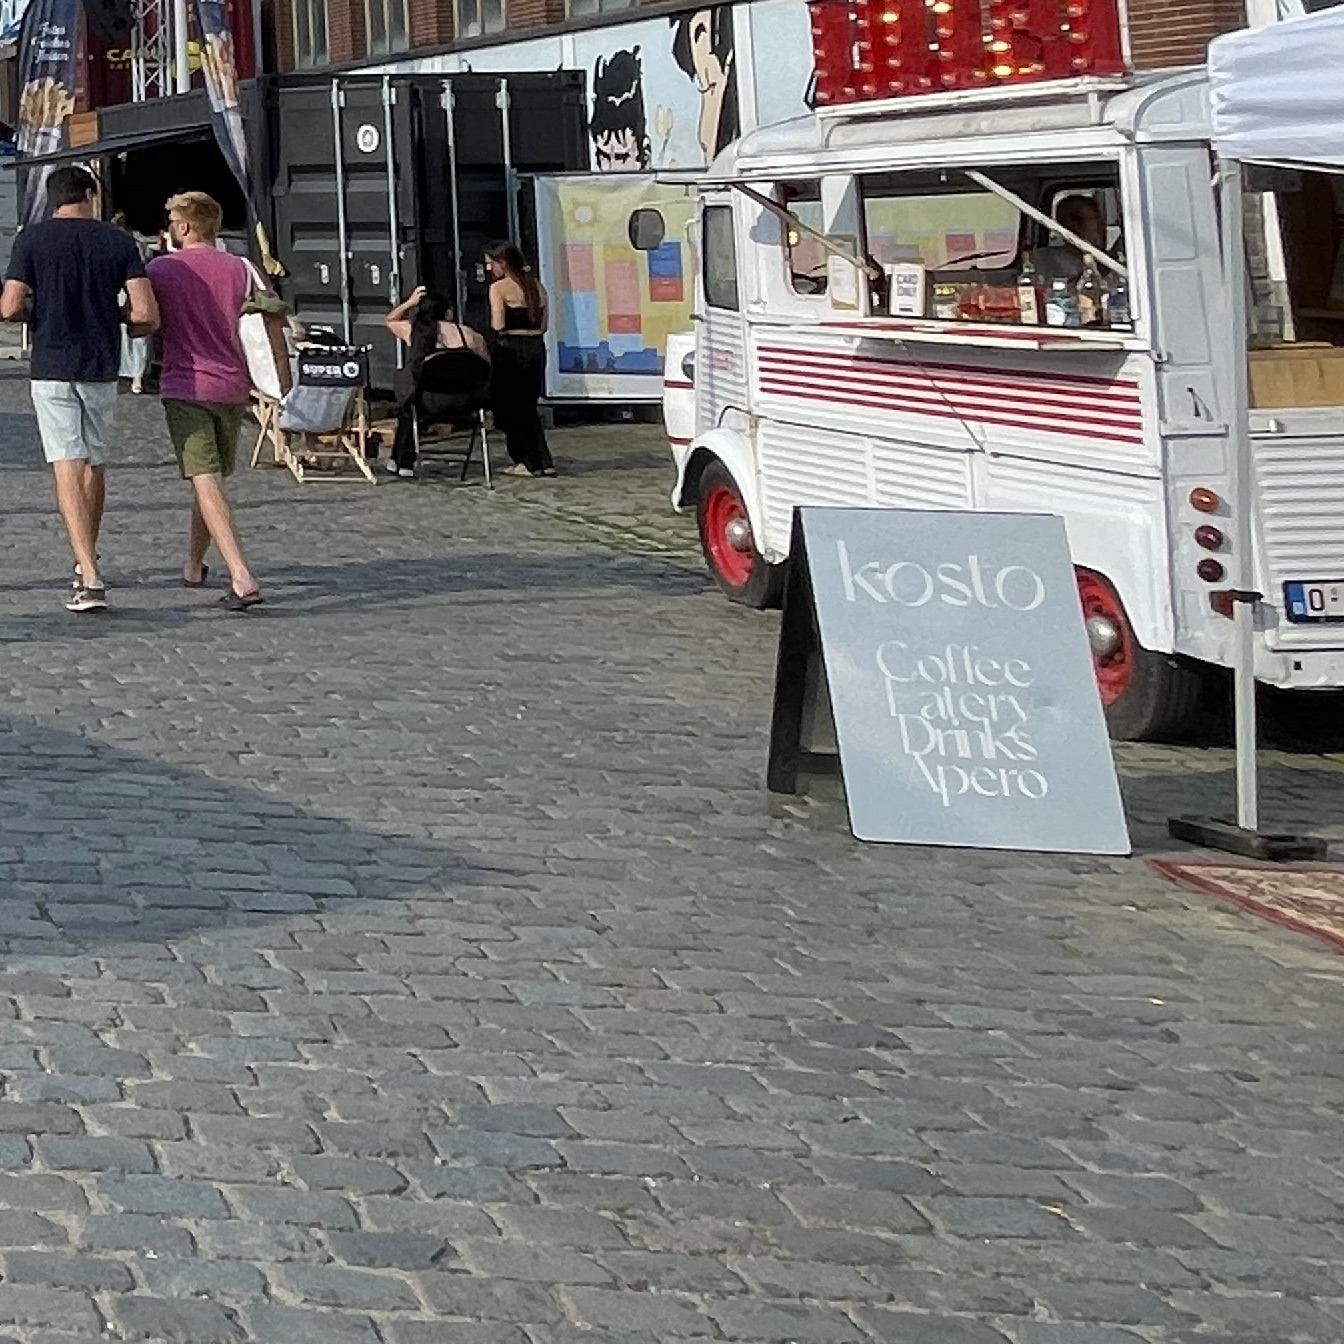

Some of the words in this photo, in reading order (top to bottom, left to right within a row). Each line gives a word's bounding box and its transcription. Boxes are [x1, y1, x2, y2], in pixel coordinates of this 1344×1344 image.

[837, 540, 1046, 611] kosto
[877, 640, 1036, 688] Coffee
[899, 713, 1039, 761] Drinks
